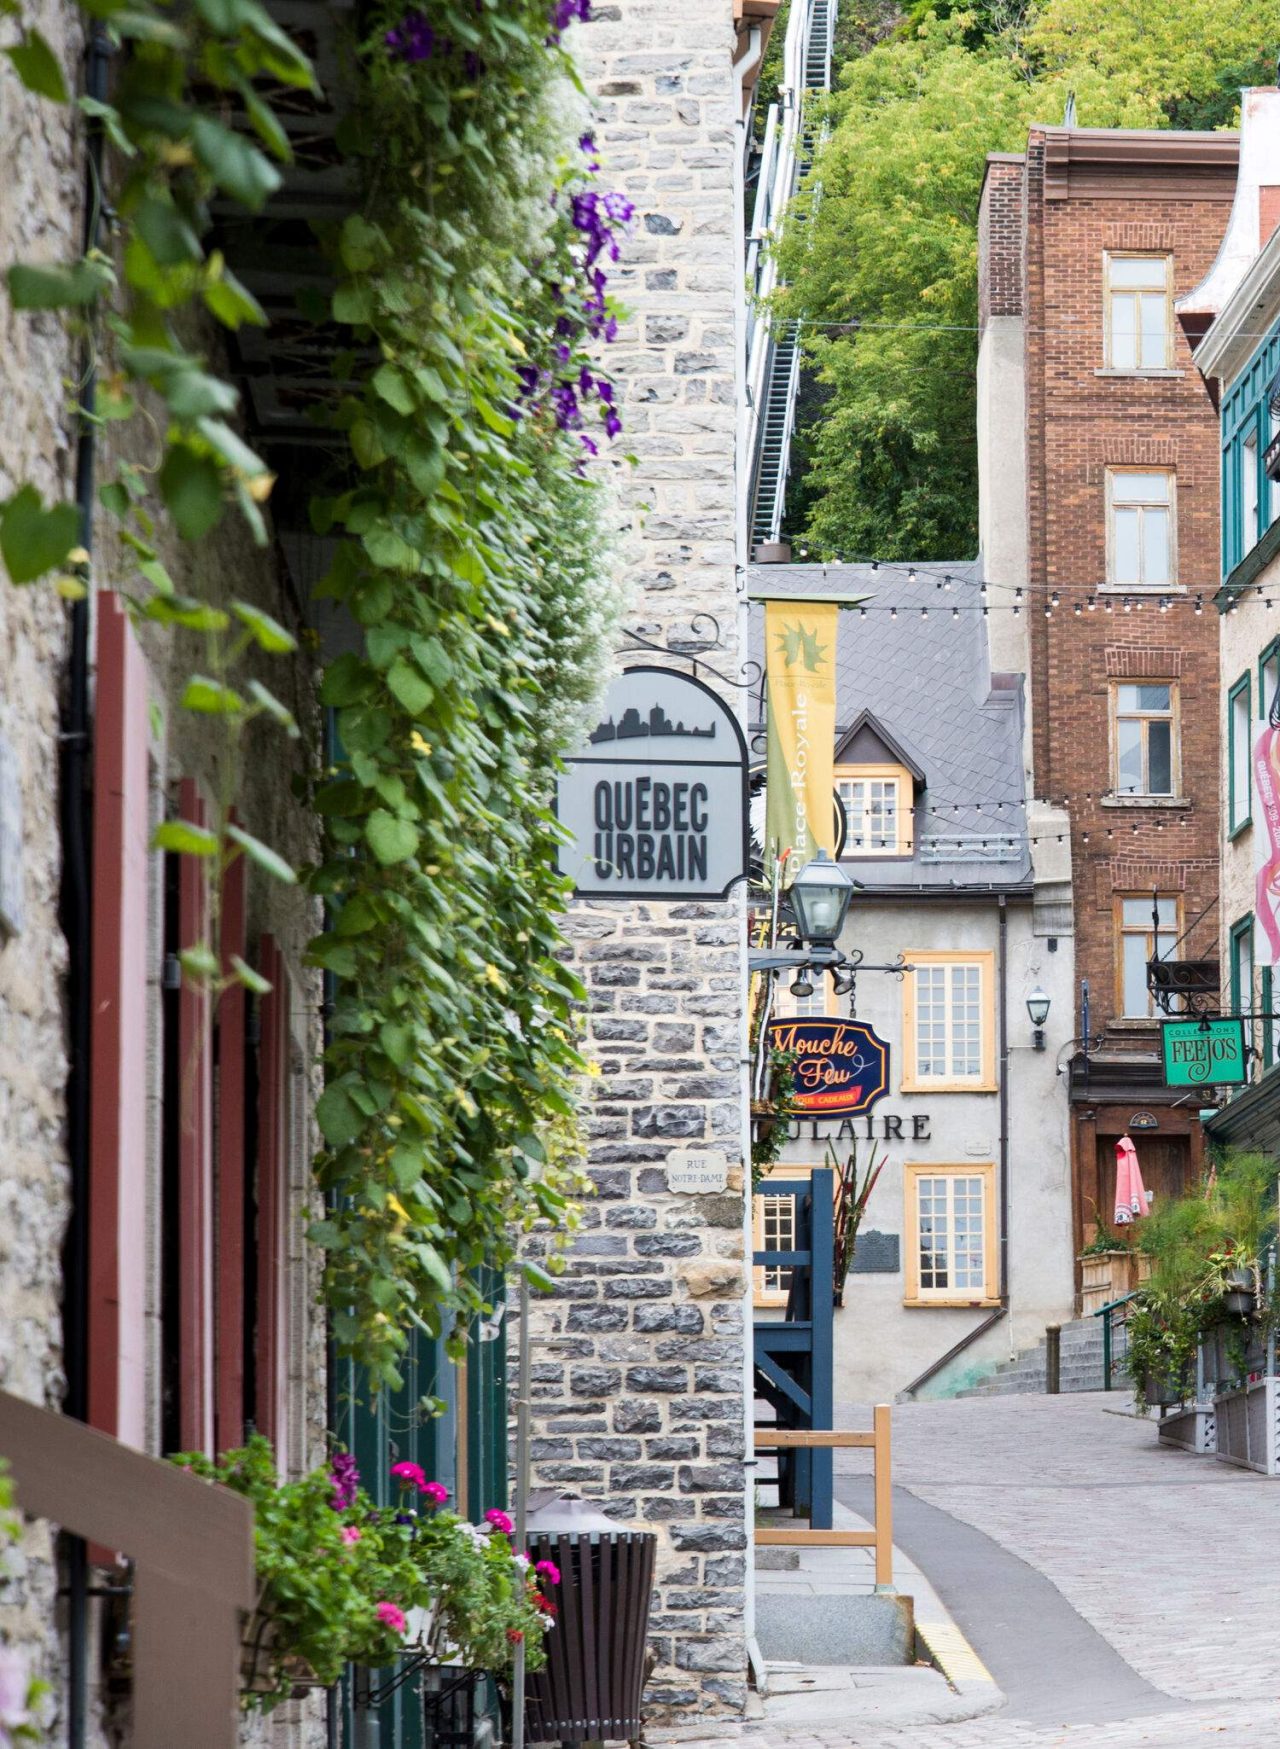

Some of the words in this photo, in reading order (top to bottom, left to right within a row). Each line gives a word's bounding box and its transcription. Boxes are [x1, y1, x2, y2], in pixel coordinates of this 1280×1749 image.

[790, 693, 810, 873] Place-Royale
[594, 776, 708, 832] QUÉBEC
[594, 832, 708, 881] URBAIN
[1168, 1027, 1236, 1036] COLLEIONS
[798, 1057, 850, 1087] Feu
[671, 1173, 724, 1183] NOTRE-DAME
[686, 1160, 707, 1169] RUE
